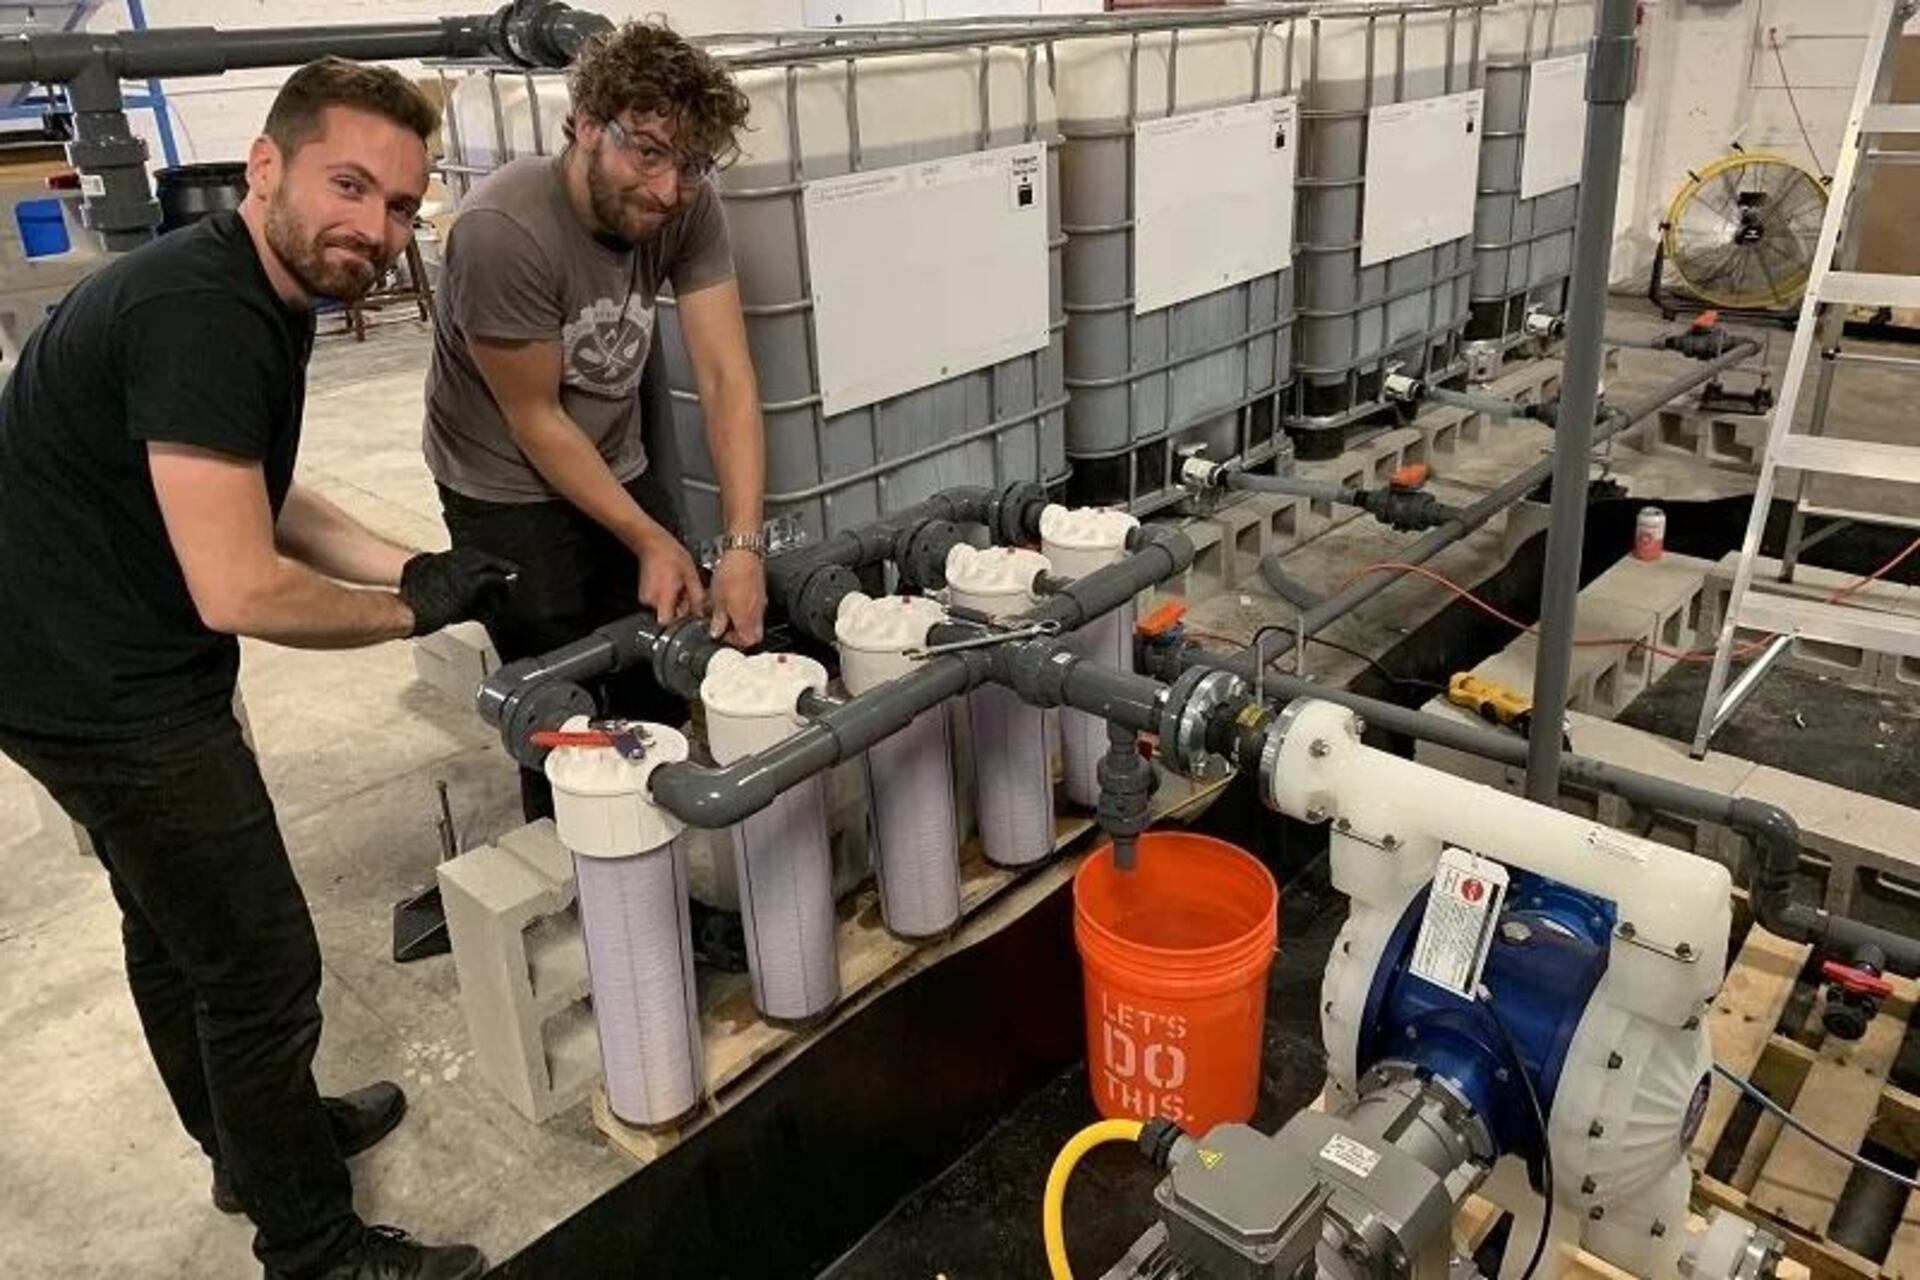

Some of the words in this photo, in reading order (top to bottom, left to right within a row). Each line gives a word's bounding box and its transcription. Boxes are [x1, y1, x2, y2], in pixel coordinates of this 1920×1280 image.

[1103, 991, 1187, 1038] LET'S
[1103, 1020, 1186, 1089] DO
[1103, 1069, 1196, 1122] THIS.
